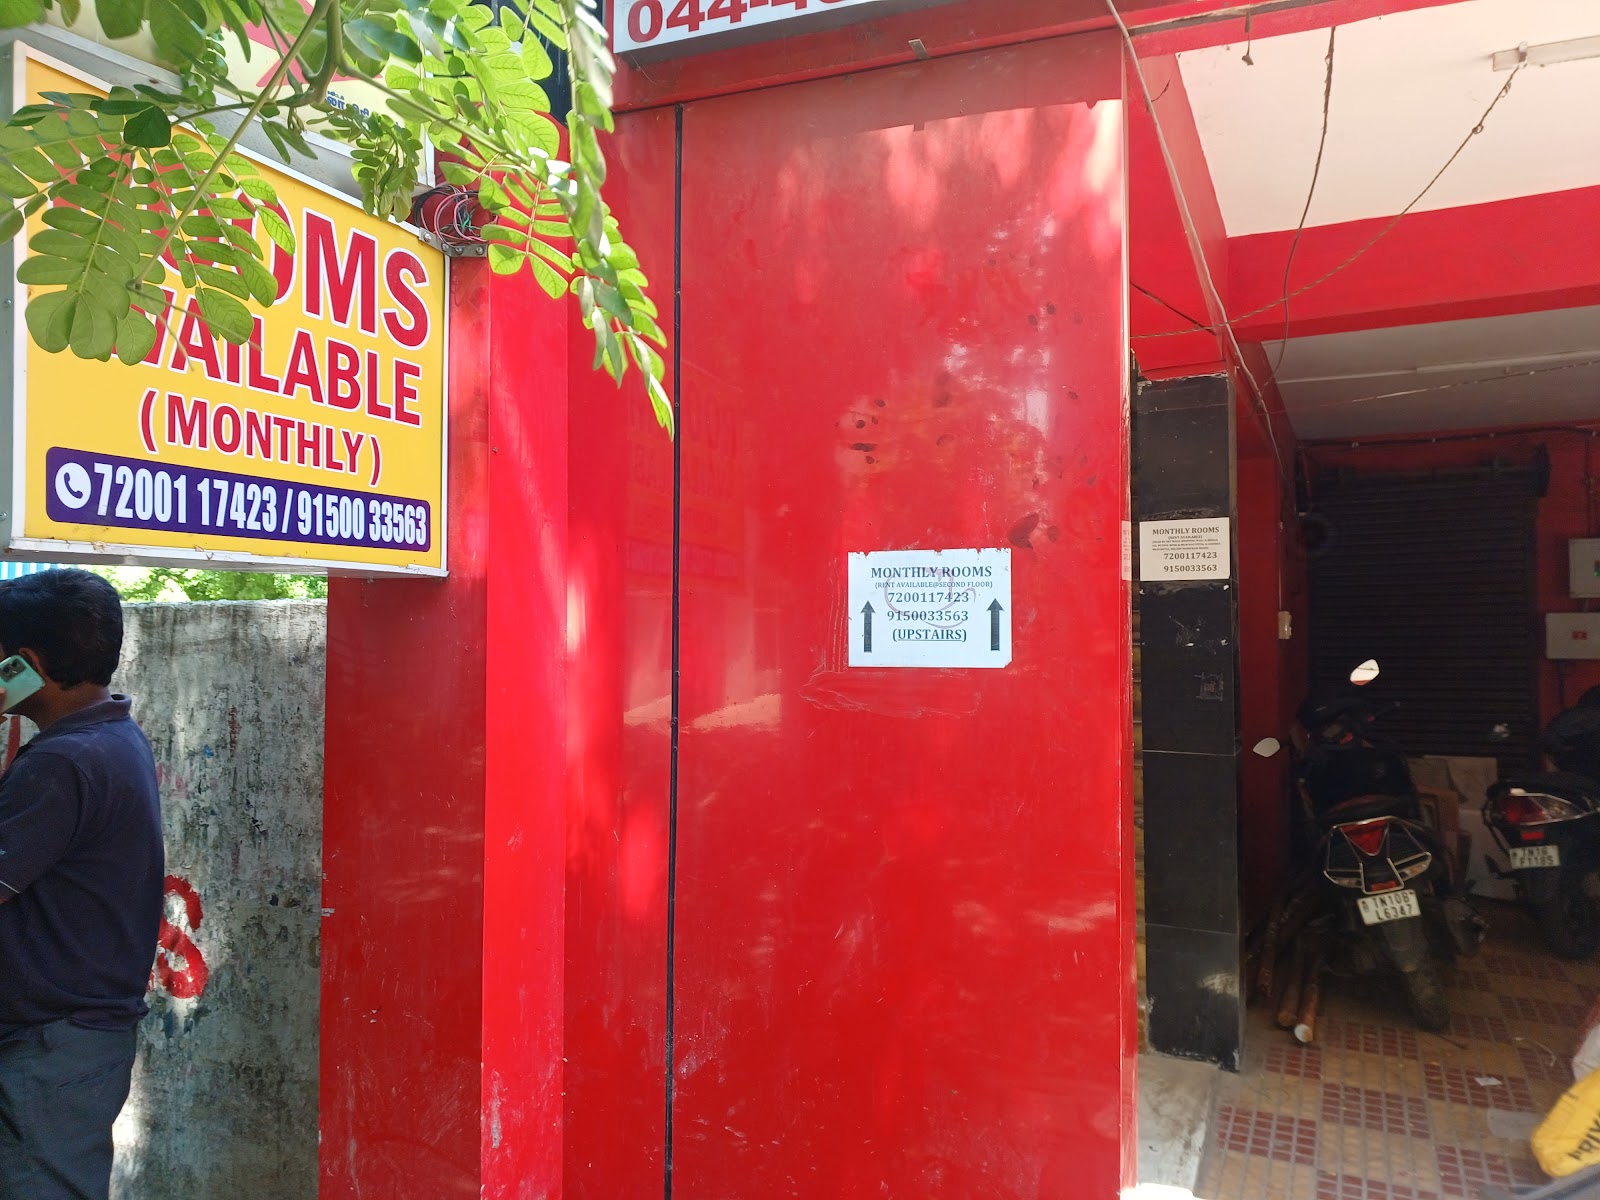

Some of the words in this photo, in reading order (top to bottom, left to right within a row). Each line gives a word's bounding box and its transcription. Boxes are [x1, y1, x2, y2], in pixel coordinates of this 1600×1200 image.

[627, 0, 850, 43] 044-
[46, 98, 429, 347] OMS
[108, 285, 421, 427] VAILABLE
[140, 389, 382, 486] (MONTHLY)
[94, 462, 187, 524] 72001
[197, 477, 277, 533] 17423
[298, 488, 364, 540] 91500
[369, 499, 427, 546] 33563
[1152, 527, 1190, 535] MONTHLY
[1191, 526, 1220, 534] ROOMS
[1163, 551, 1218, 560] 7200117423
[871, 566, 938, 578] MONTHLY
[942, 565, 993, 578] ROOMS
[1163, 564, 1218, 573] 9150033563
[875, 581, 895, 589] (RENT
[887, 591, 969, 603] 7200117423
[887, 610, 969, 621] 9150033563
[892, 628, 967, 642] (UPSTAIRS)
